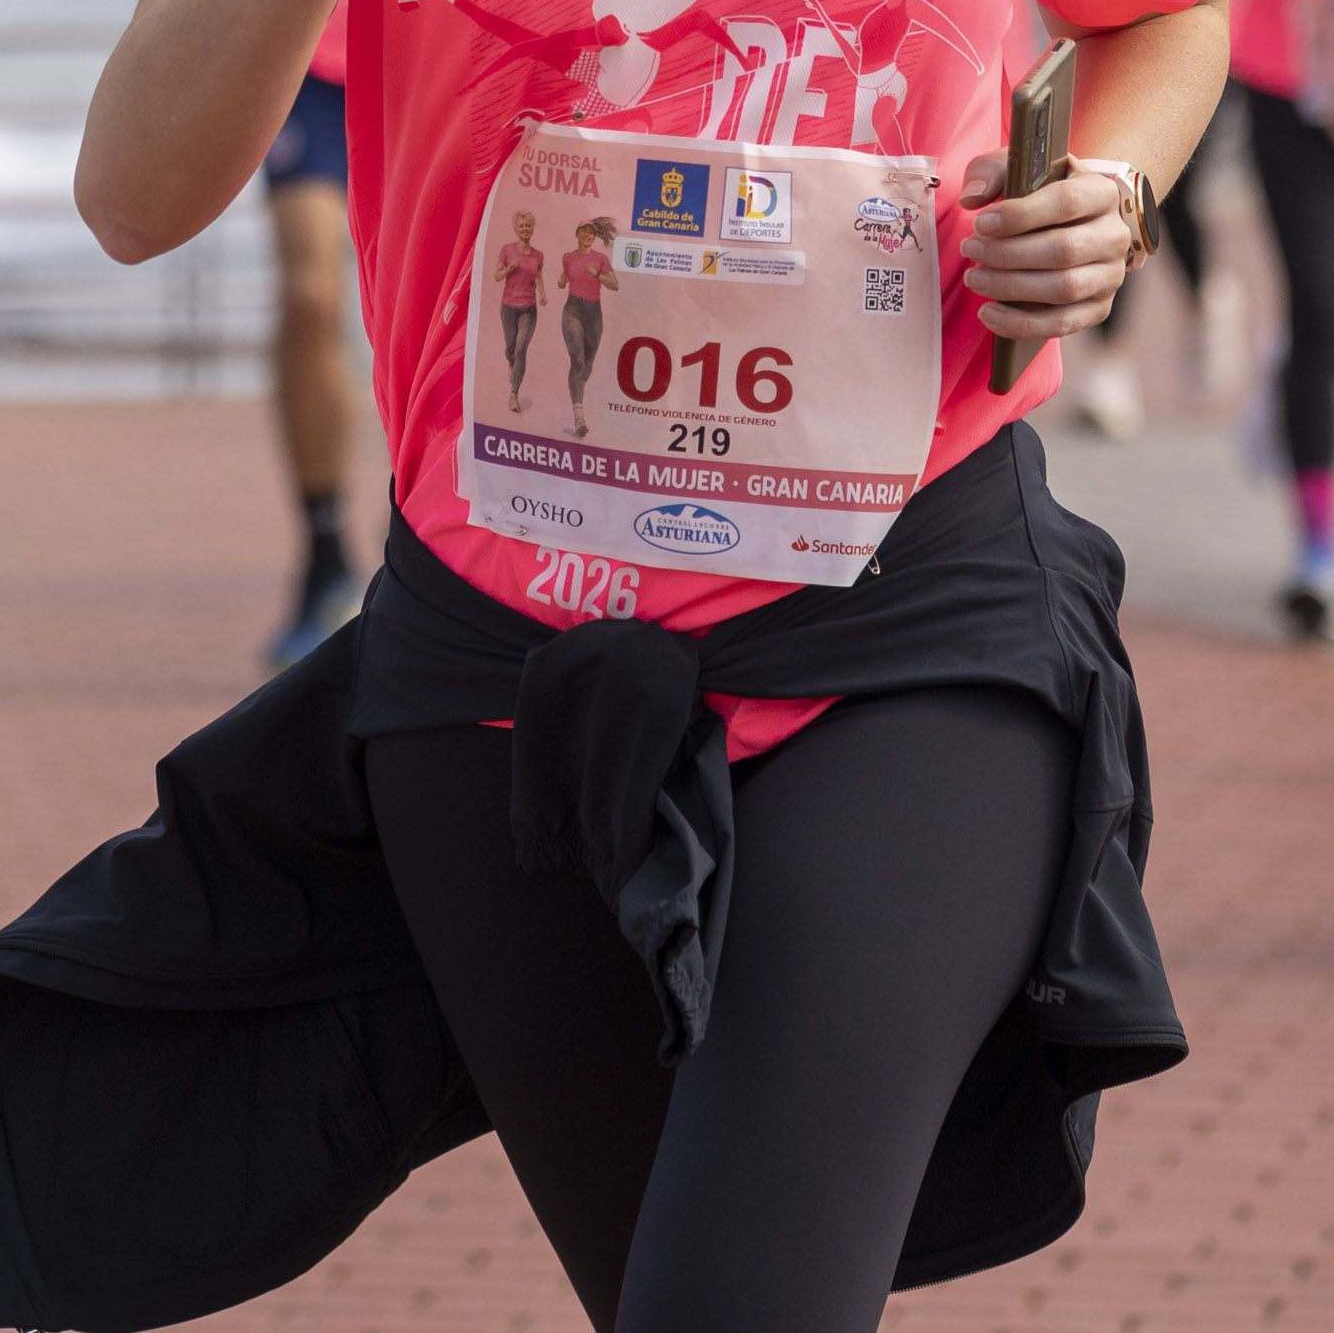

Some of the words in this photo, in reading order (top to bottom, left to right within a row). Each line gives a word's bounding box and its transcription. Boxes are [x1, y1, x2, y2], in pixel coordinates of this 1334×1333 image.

[537, 150, 601, 172] DORSAL
[518, 163, 600, 199] SUMA
[637, 218, 661, 229] Gran
[662, 220, 700, 232] Canaria
[642, 209, 679, 221] Cabildo
[681, 211, 694, 222] de
[854, 218, 891, 235] Carrera
[740, 228, 782, 238] DEPORTES
[877, 232, 904, 253] Mujer
[646, 250, 693, 260] Ayuntamiento
[616, 336, 794, 414] 016
[607, 402, 660, 417] TELÉFONO
[662, 409, 716, 422] VIOLENCIA
[718, 415, 732, 424] DE
[733, 416, 777, 427] GÉNERO
[667, 423, 731, 457] 219
[483, 435, 574, 473] CARRERA
[581, 454, 608, 478] DE
[614, 460, 640, 484] LA
[648, 464, 725, 492] MUJER
[746, 474, 809, 500] GRAN
[816, 480, 905, 505] CANARIA
[511, 495, 584, 527] OYSHO
[641, 517, 732, 545] ASTURIANA
[526, 545, 639, 620] 2026
